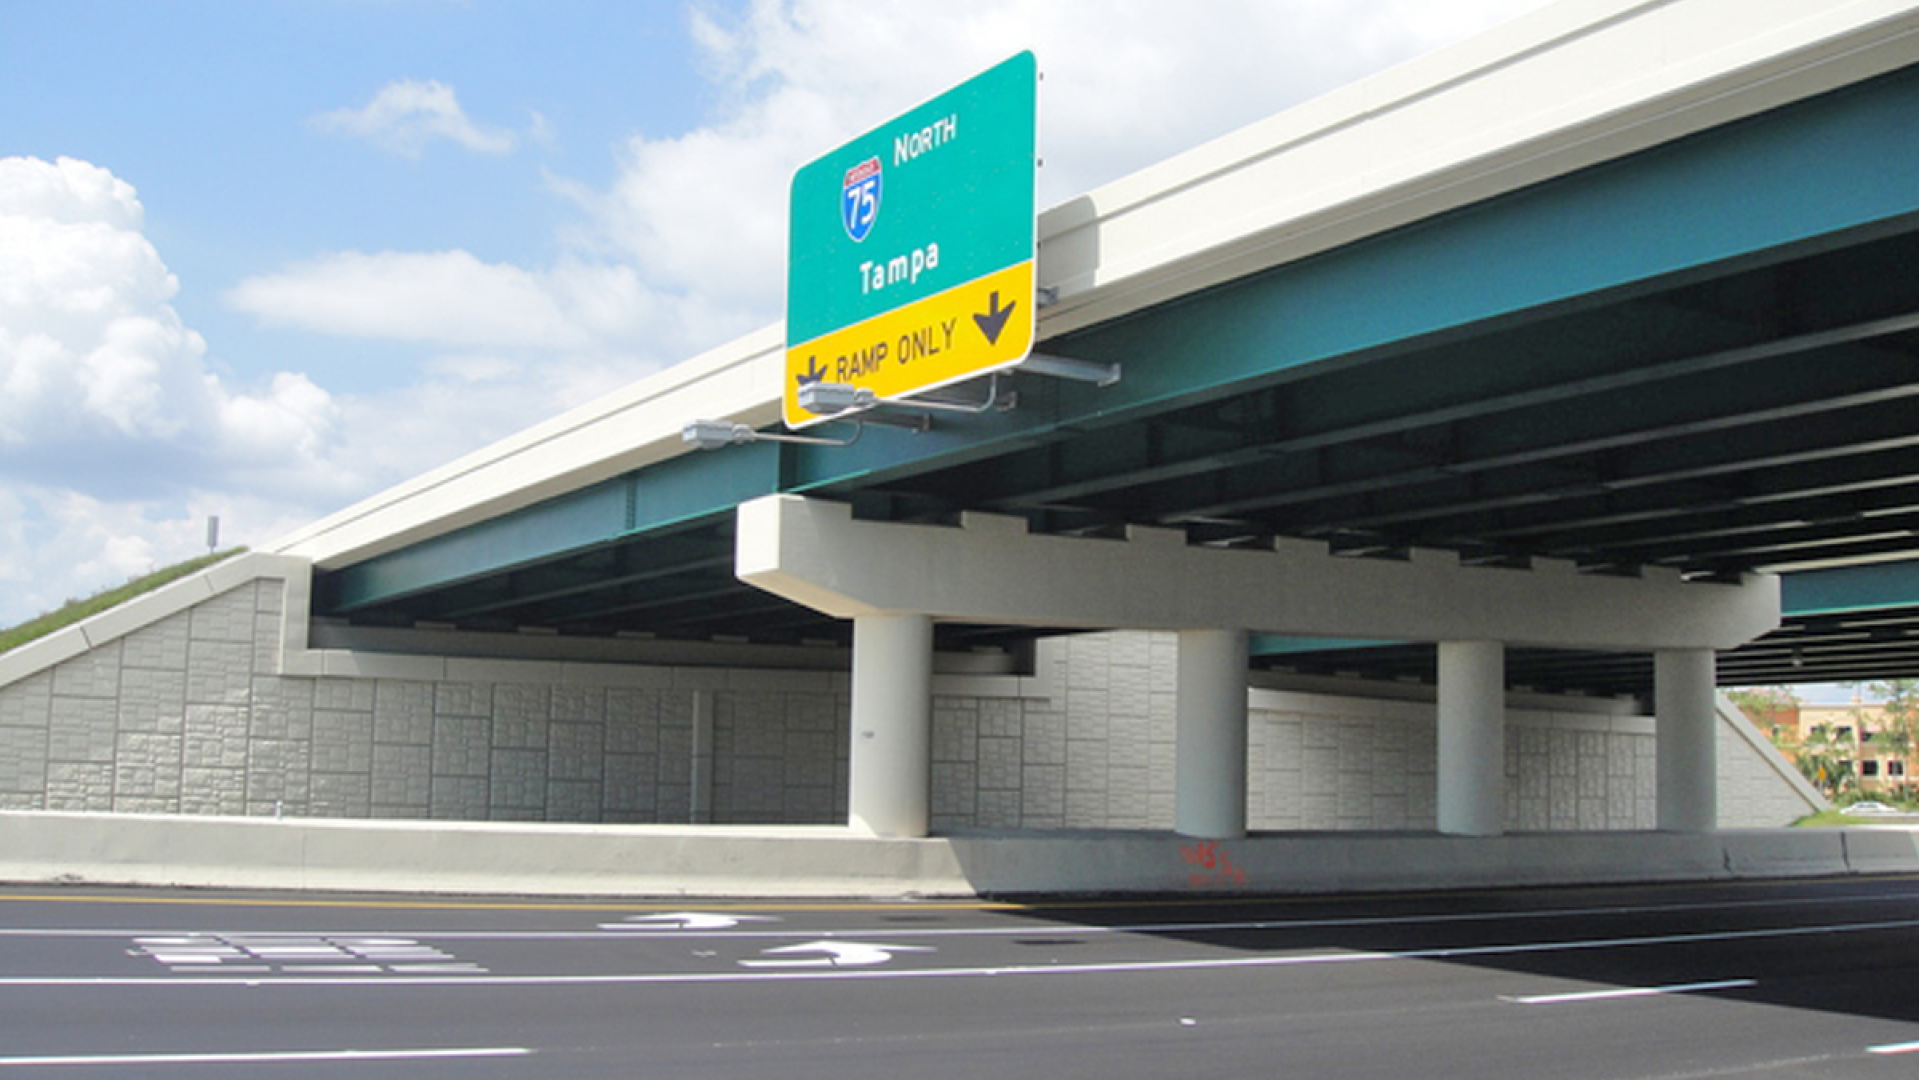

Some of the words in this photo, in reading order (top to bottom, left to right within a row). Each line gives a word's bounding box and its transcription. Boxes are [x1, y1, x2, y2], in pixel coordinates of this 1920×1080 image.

[894, 113, 957, 167] NORTH
[848, 180, 875, 230] 75
[859, 242, 938, 295] Tampa
[837, 342, 888, 382] RAMP
[897, 318, 957, 365] ONLY
